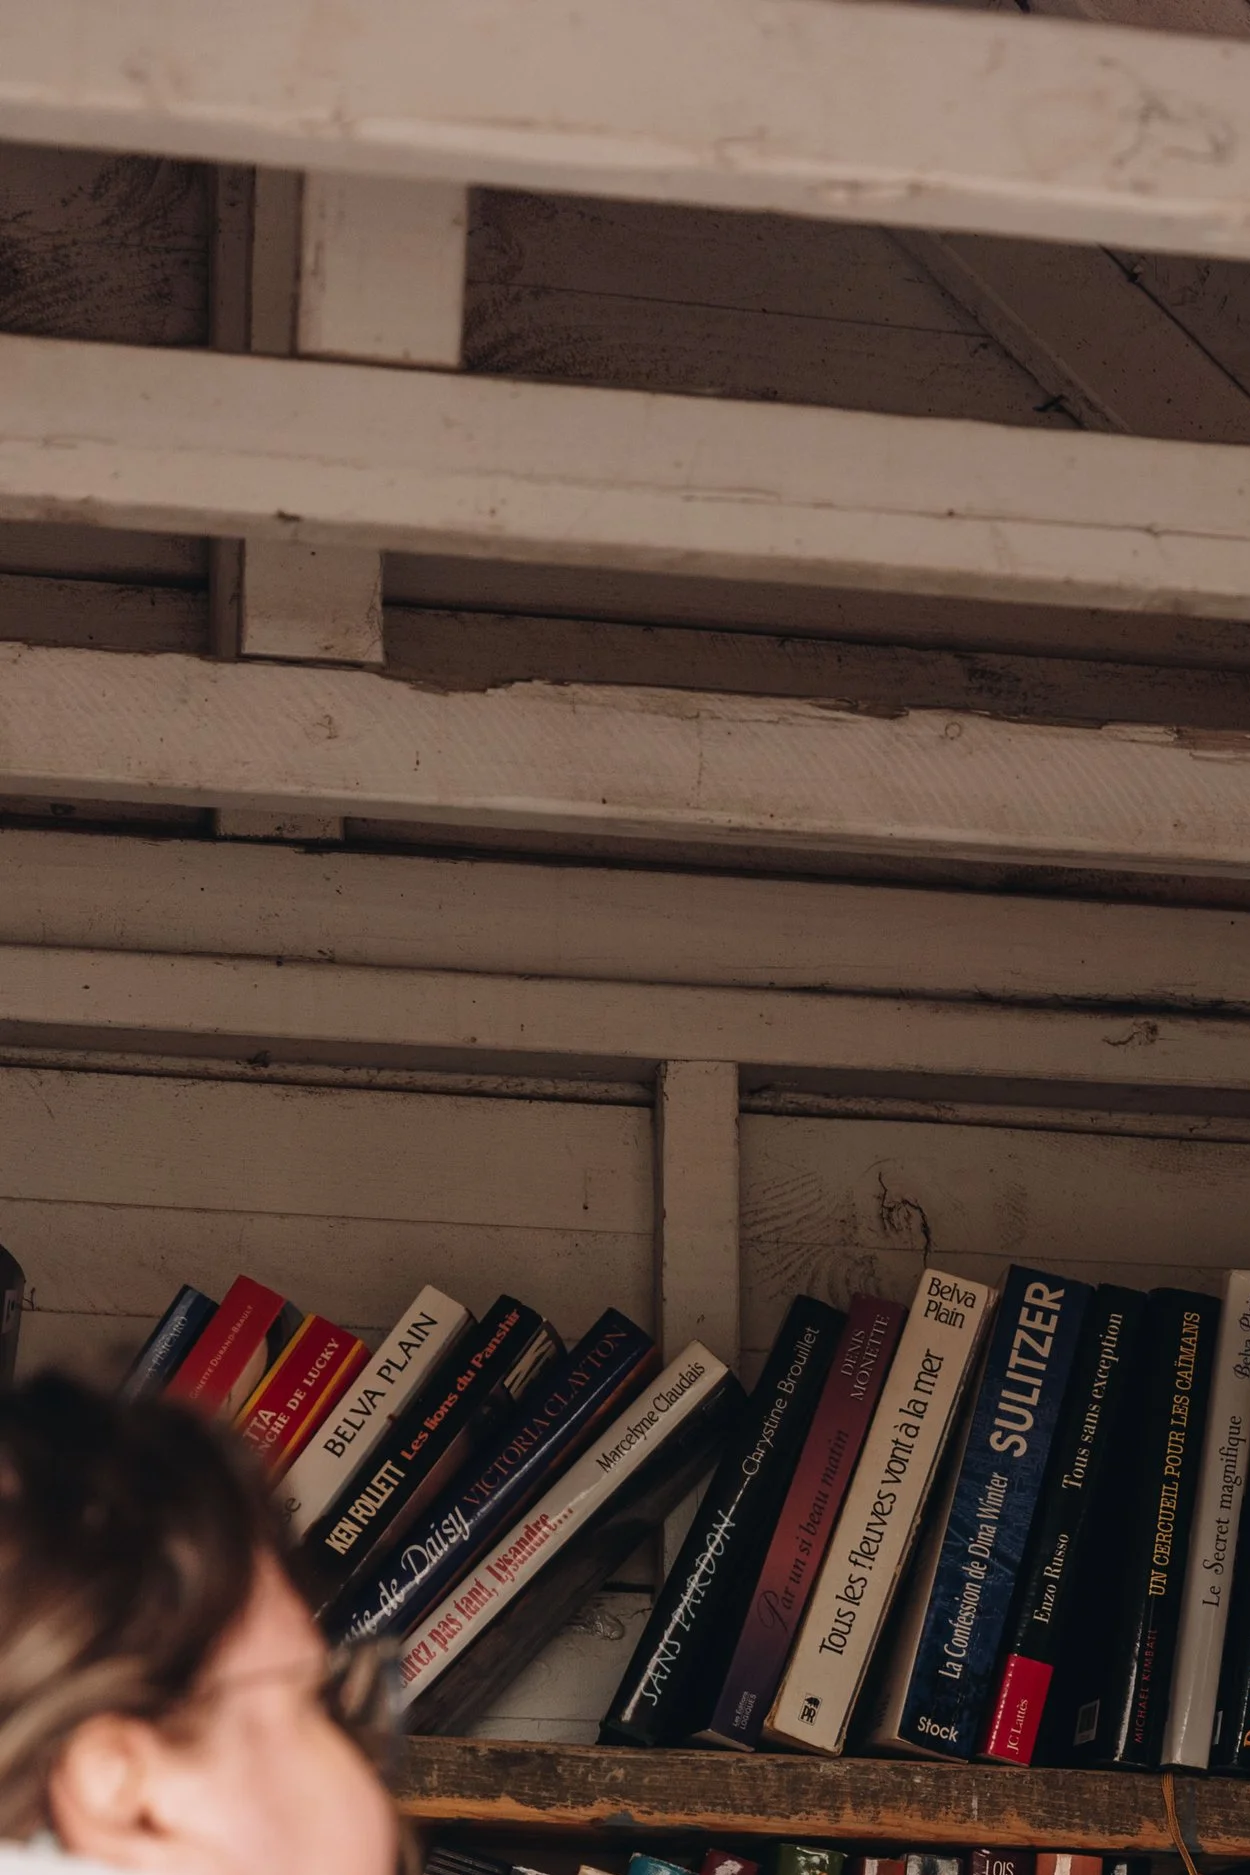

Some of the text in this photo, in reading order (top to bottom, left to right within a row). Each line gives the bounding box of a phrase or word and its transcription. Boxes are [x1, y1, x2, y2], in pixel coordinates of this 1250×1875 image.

[840, 1329, 866, 1377] DENIS
[850, 1314, 890, 1401] MONETTE
[924, 1299, 964, 1329] Plain
[928, 1278, 977, 1309] Belva
[989, 1281, 1066, 1458] SULITZER
[323, 1311, 439, 1458] BELVA PLAIN
[325, 1308, 521, 1555] KEN FOLLETT Les lions du Panshir
[379, 1324, 629, 1616] de Daisy VICTORIA CLAYTON
[1062, 1312, 1123, 1490] Tous sans exception
[1149, 1311, 1201, 1597] UN CERCUEIL POUR LES CAÏMANS
[428, 1612, 463, 1653] pas
[454, 1577, 499, 1621] tant,
[596, 1404, 660, 1475] Marcelyne
[653, 1359, 706, 1414] Claudais
[642, 1326, 820, 1706] SANS PARDON Chrystine Brouillet
[819, 1349, 944, 1656] Tous les fleuves vont à la mer
[938, 1471, 1009, 1680] La Confession de Dina Winter
[1033, 1532, 1070, 1625] Enzo Russo
[1202, 1414, 1248, 1608] Le Secret magnifique
[917, 1715, 959, 1743] Stock
